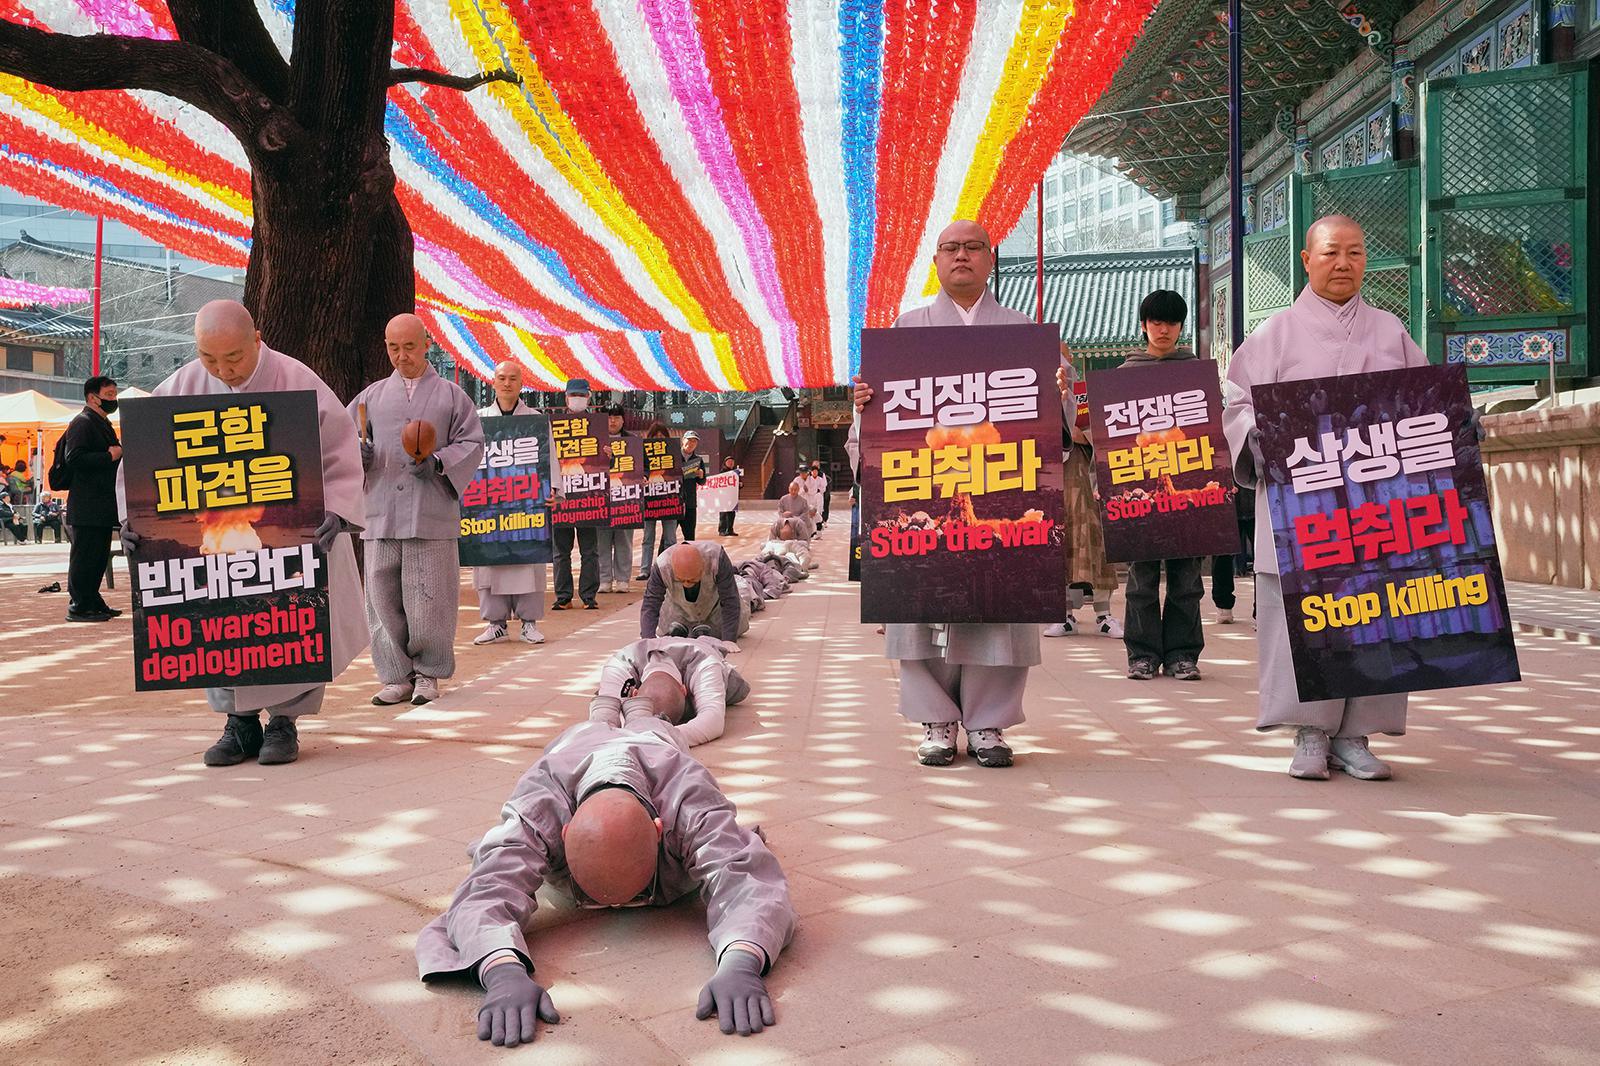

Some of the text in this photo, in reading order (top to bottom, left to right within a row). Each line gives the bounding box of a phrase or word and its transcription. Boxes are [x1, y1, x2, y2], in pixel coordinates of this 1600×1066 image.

[883, 367, 1039, 432] 전쟁을
[1103, 389, 1209, 438] 전쟁을
[174, 405, 267, 459] 군함
[552, 418, 589, 438] 군함
[477, 436, 539, 469] 생을
[611, 440, 627, 456] 함
[648, 455, 674, 471] 견을
[1107, 435, 1215, 485] 멈춰라
[1286, 412, 1456, 494] 살생을
[154, 455, 293, 512] 파견을
[562, 472, 607, 493] 한다
[881, 438, 1042, 503] 멈춰라
[463, 473, 540, 507] 멈춰라
[560, 495, 605, 510] warship
[610, 484, 642, 502] 한다
[643, 480, 681, 497] 대한다
[647, 497, 680, 509] warship
[1106, 486, 1228, 521] Stop the war
[460, 512, 545, 536] Stop killing
[552, 507, 608, 524] ployment!
[610, 504, 640, 516] arship
[644, 505, 683, 518] loyment!
[870, 526, 938, 558] Stop
[944, 521, 993, 552] the
[1000, 518, 1055, 549] war
[1294, 488, 1468, 571] 멈춰라
[138, 544, 320, 607] 반대한다
[1301, 573, 1489, 633] Stop killing
[147, 603, 316, 649] No warship
[142, 633, 324, 682] deployment!
